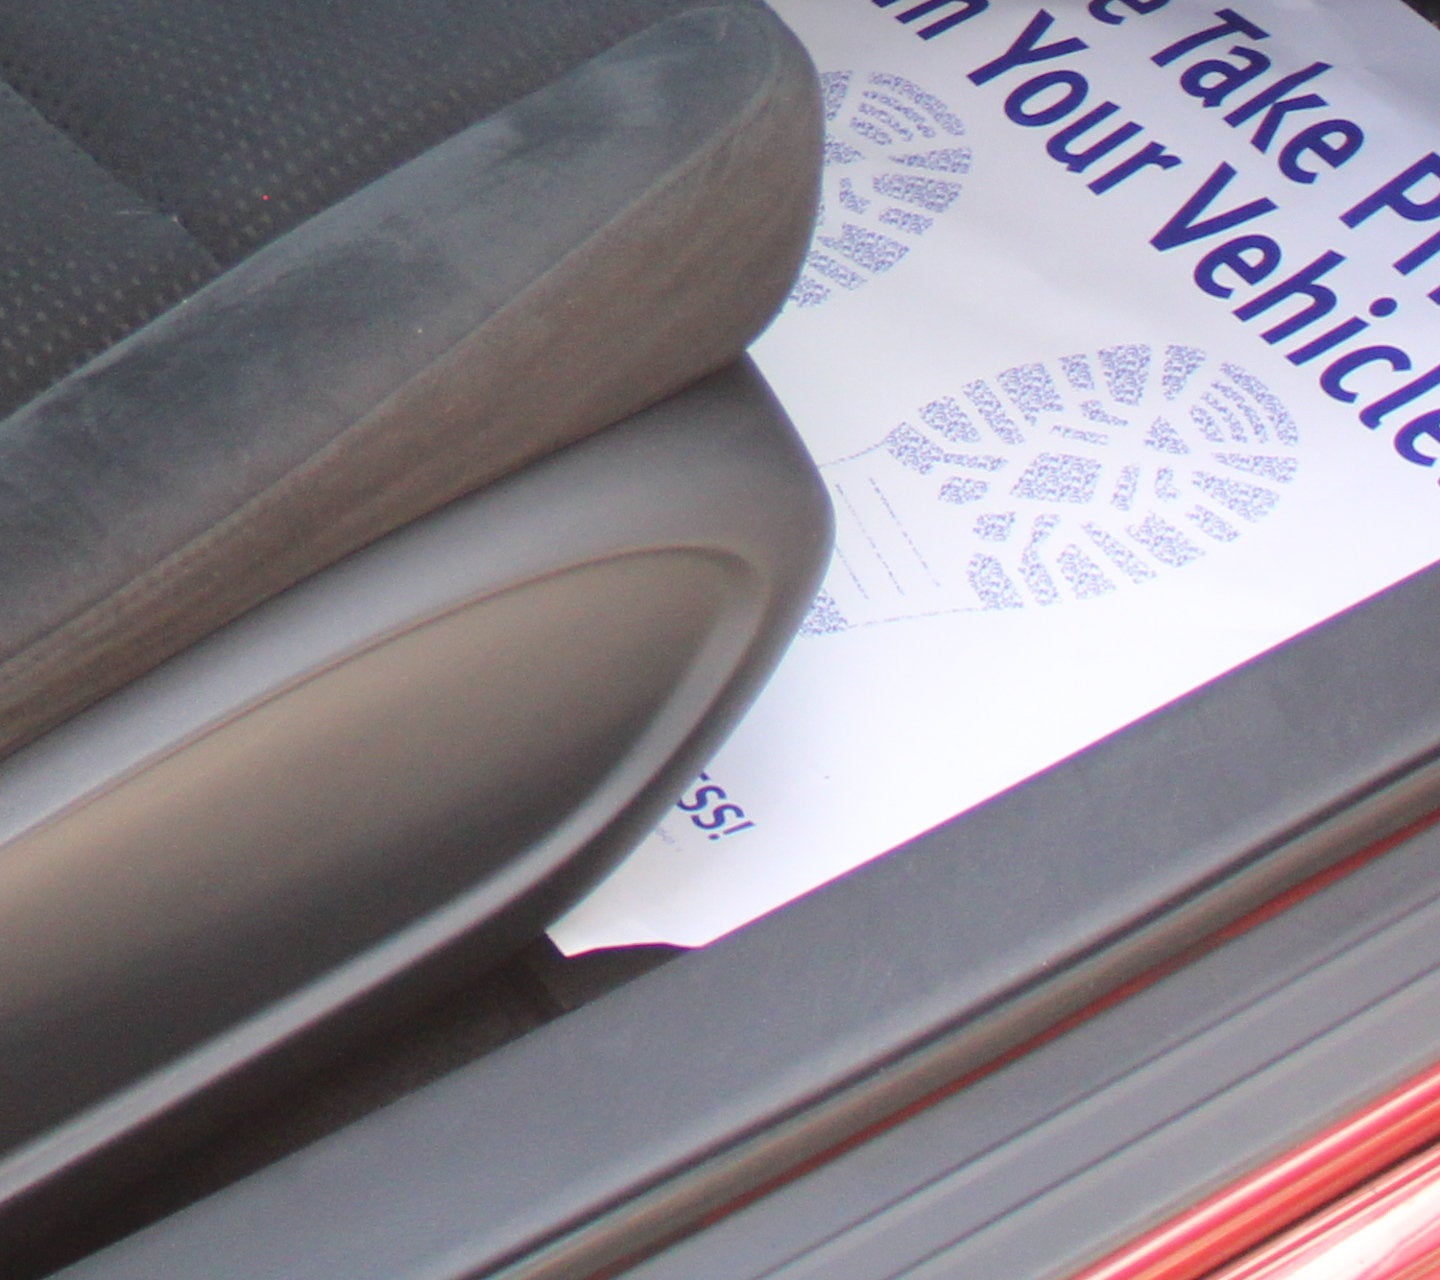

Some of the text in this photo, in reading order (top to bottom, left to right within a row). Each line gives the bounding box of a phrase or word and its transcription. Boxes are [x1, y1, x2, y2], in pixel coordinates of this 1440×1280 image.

[966, 9, 1182, 195] Your
[1150, 8, 1364, 184] Take
[676, 771, 755, 840] SS!
